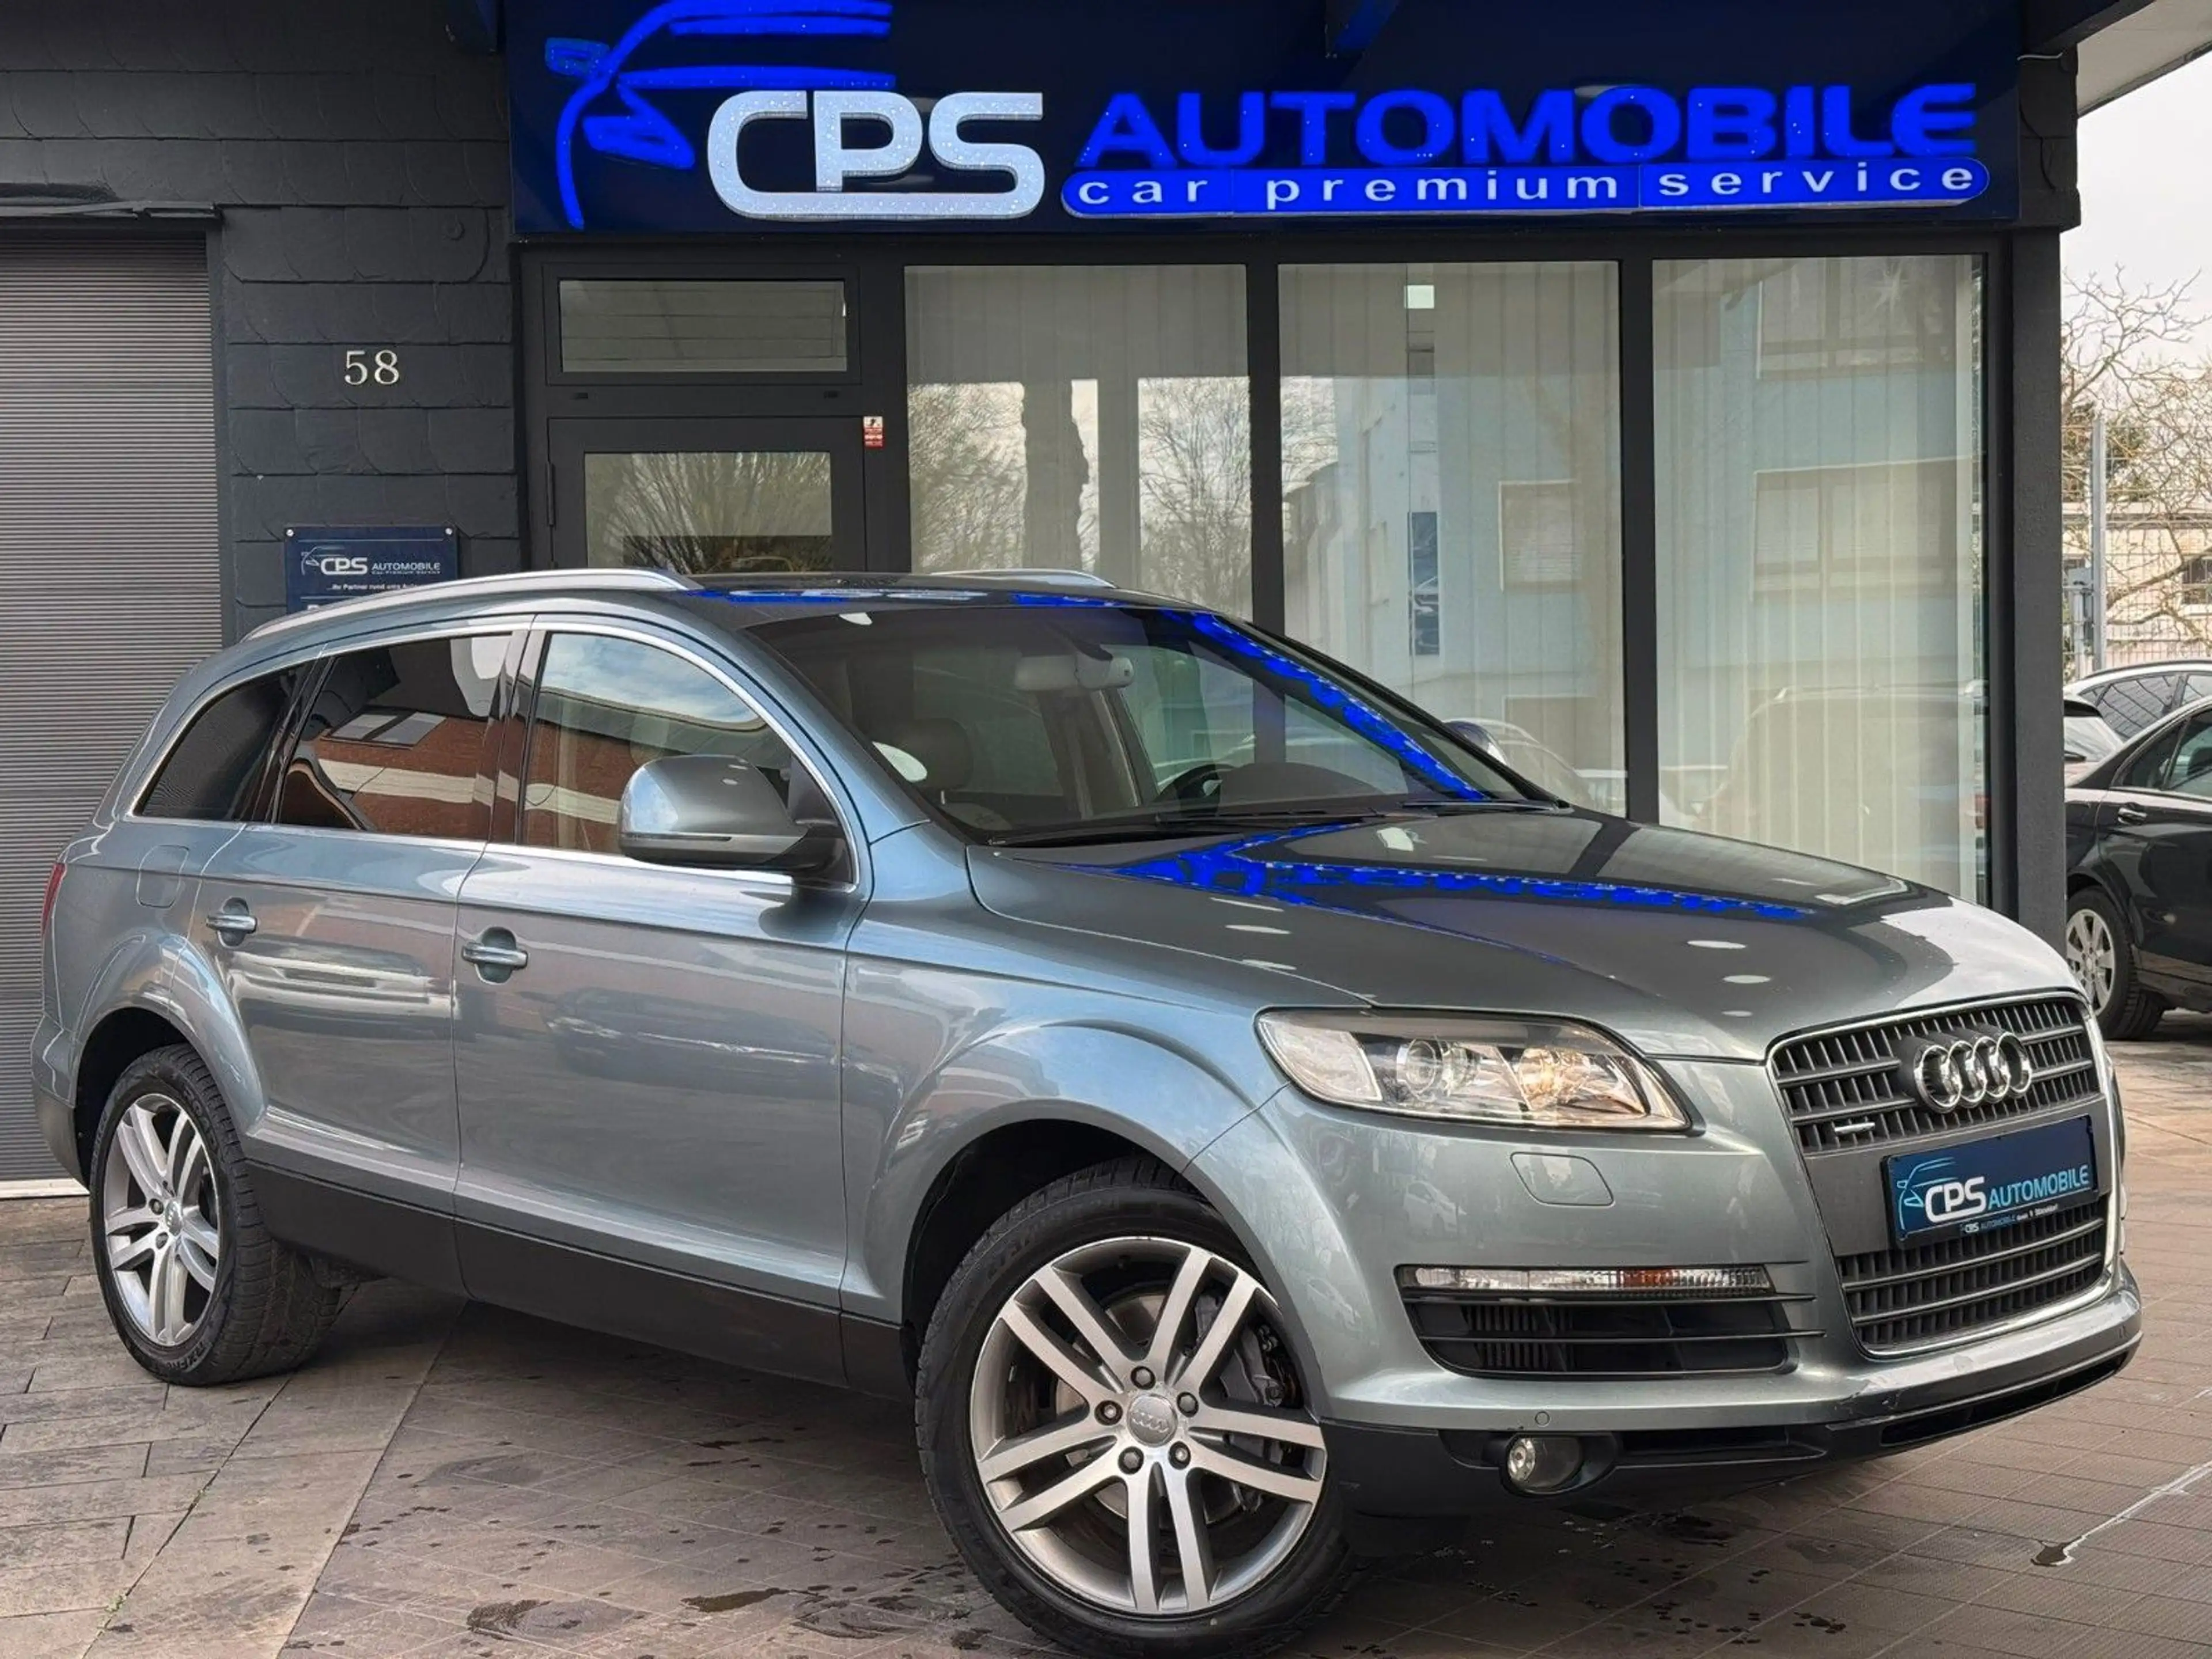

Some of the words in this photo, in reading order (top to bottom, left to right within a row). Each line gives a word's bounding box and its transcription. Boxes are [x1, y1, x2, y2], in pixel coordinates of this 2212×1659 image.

[707, 90, 1045, 220] CPS
[1074, 83, 1977, 167] AUTOMOBILE
[1078, 179, 1208, 204] car
[1267, 170, 1618, 210] premium
[1658, 162, 1973, 196] service
[344, 349, 399, 385] 58
[320, 557, 368, 575] CPS
[372, 562, 441, 571] AUTOMOBILE
[1925, 1176, 1987, 1223] CPS
[1987, 1164, 2090, 1210] AUTOMOBILE
